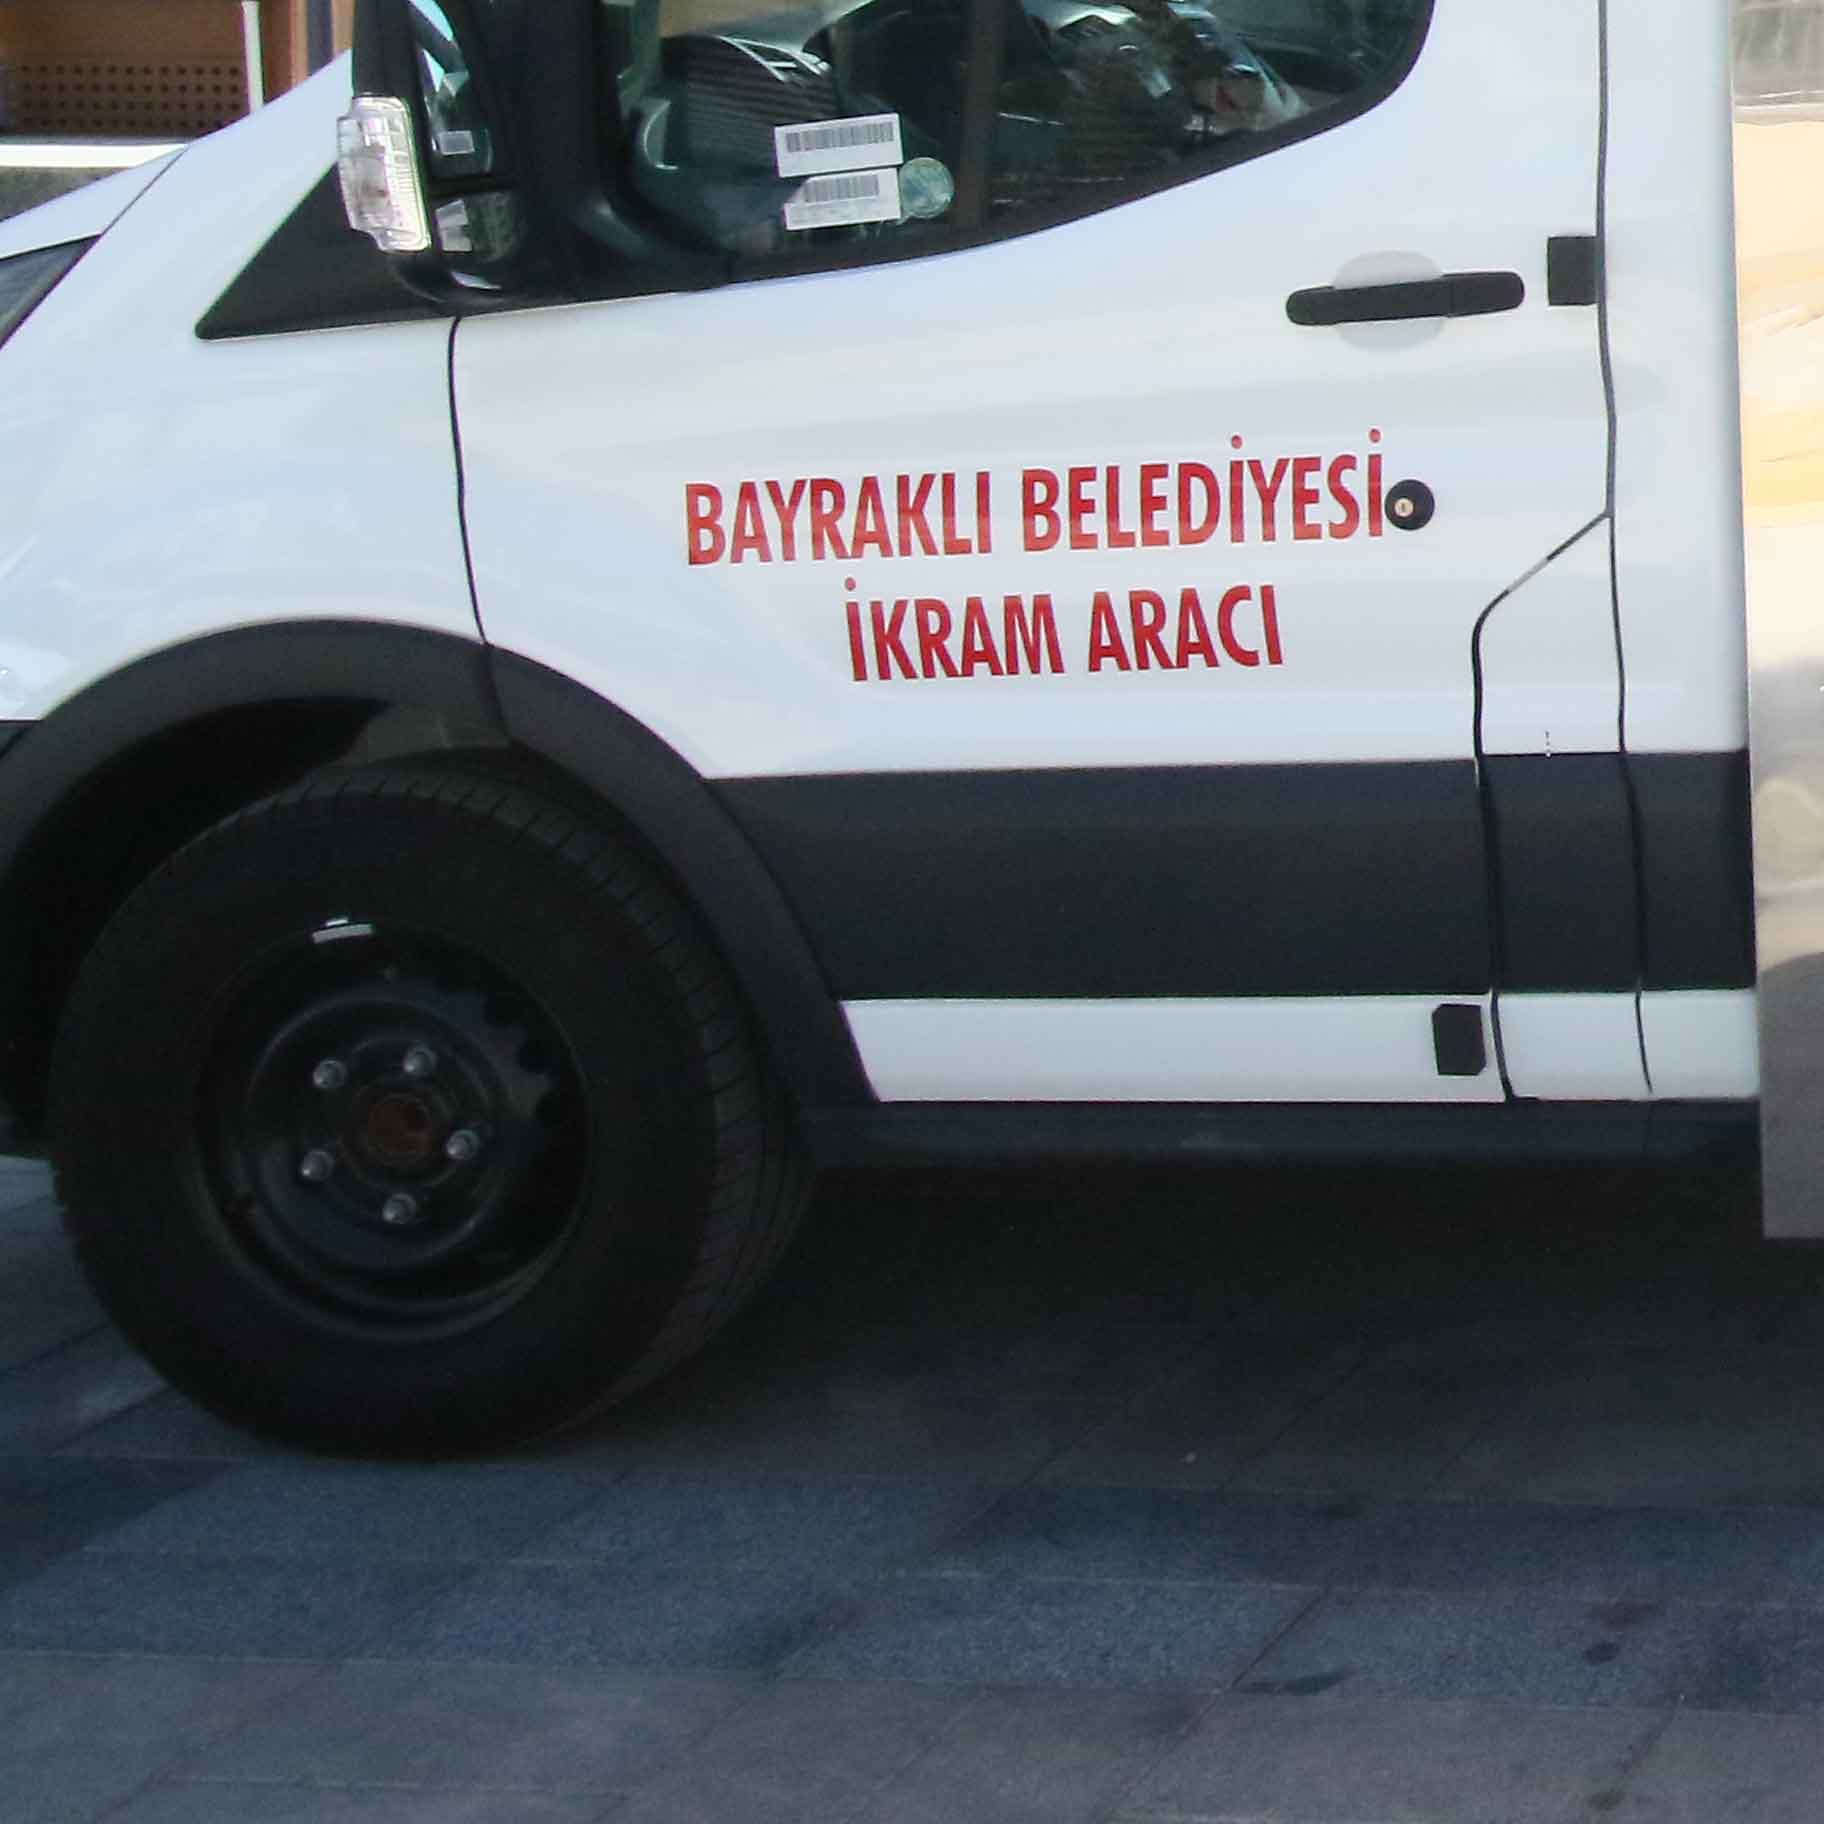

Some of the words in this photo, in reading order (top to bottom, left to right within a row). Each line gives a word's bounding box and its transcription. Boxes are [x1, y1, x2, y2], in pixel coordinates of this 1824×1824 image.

[686, 471, 992, 566] BAYRAKLI
[1022, 428, 1384, 553] BELEDİYESİ
[845, 578, 1066, 682] İKRAM
[1087, 584, 1284, 673] ARACI
